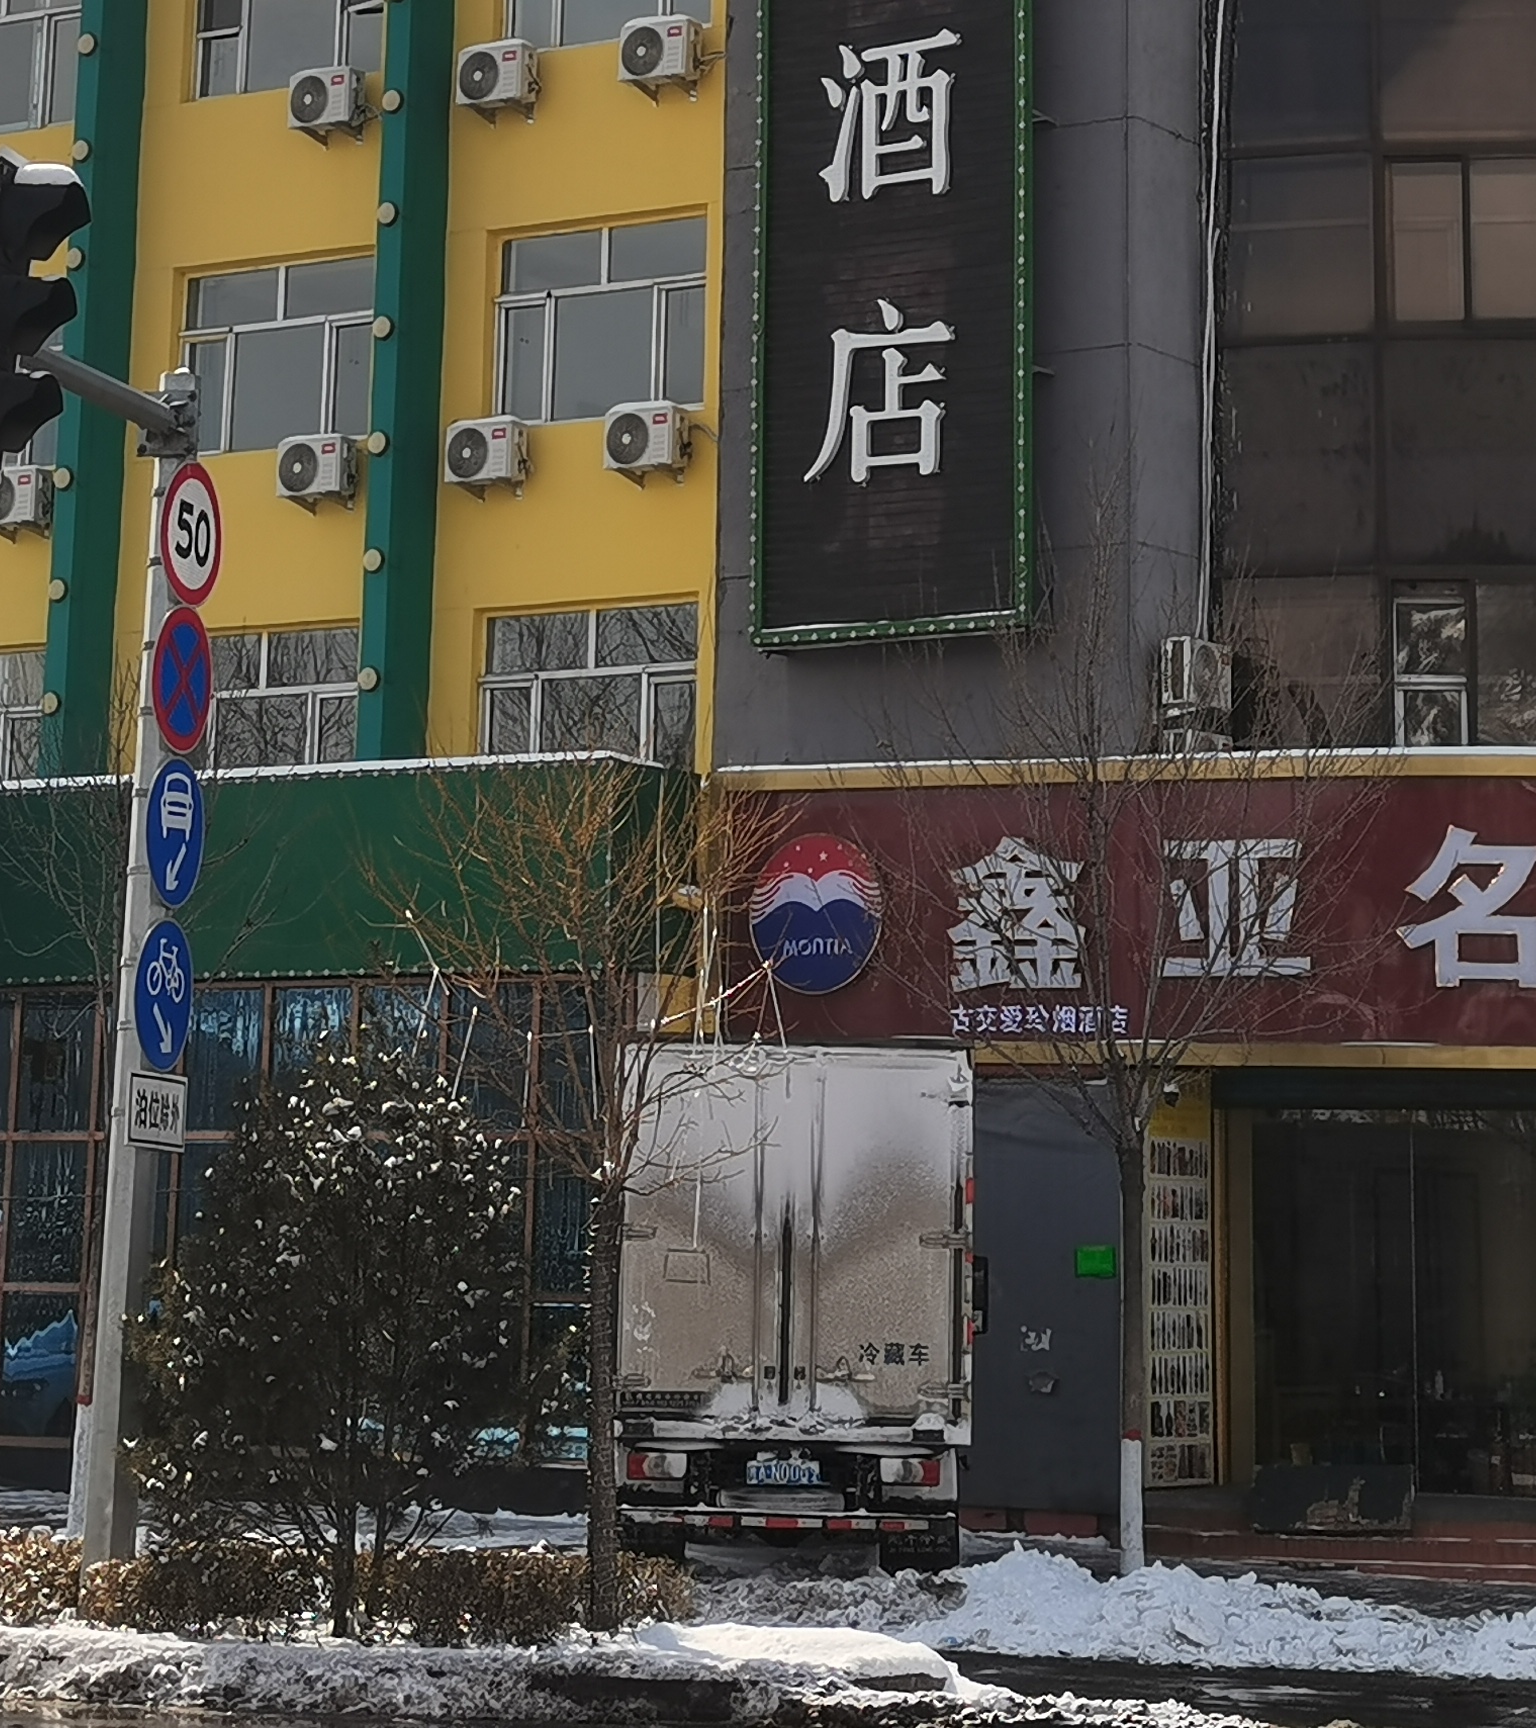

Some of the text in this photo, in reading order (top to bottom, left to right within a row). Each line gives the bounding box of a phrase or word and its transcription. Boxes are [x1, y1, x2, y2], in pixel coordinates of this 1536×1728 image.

[174, 498, 212, 566] 50
[134, 1088, 181, 1135] 泊位除外
[857, 1341, 931, 1366] 冷藏车
